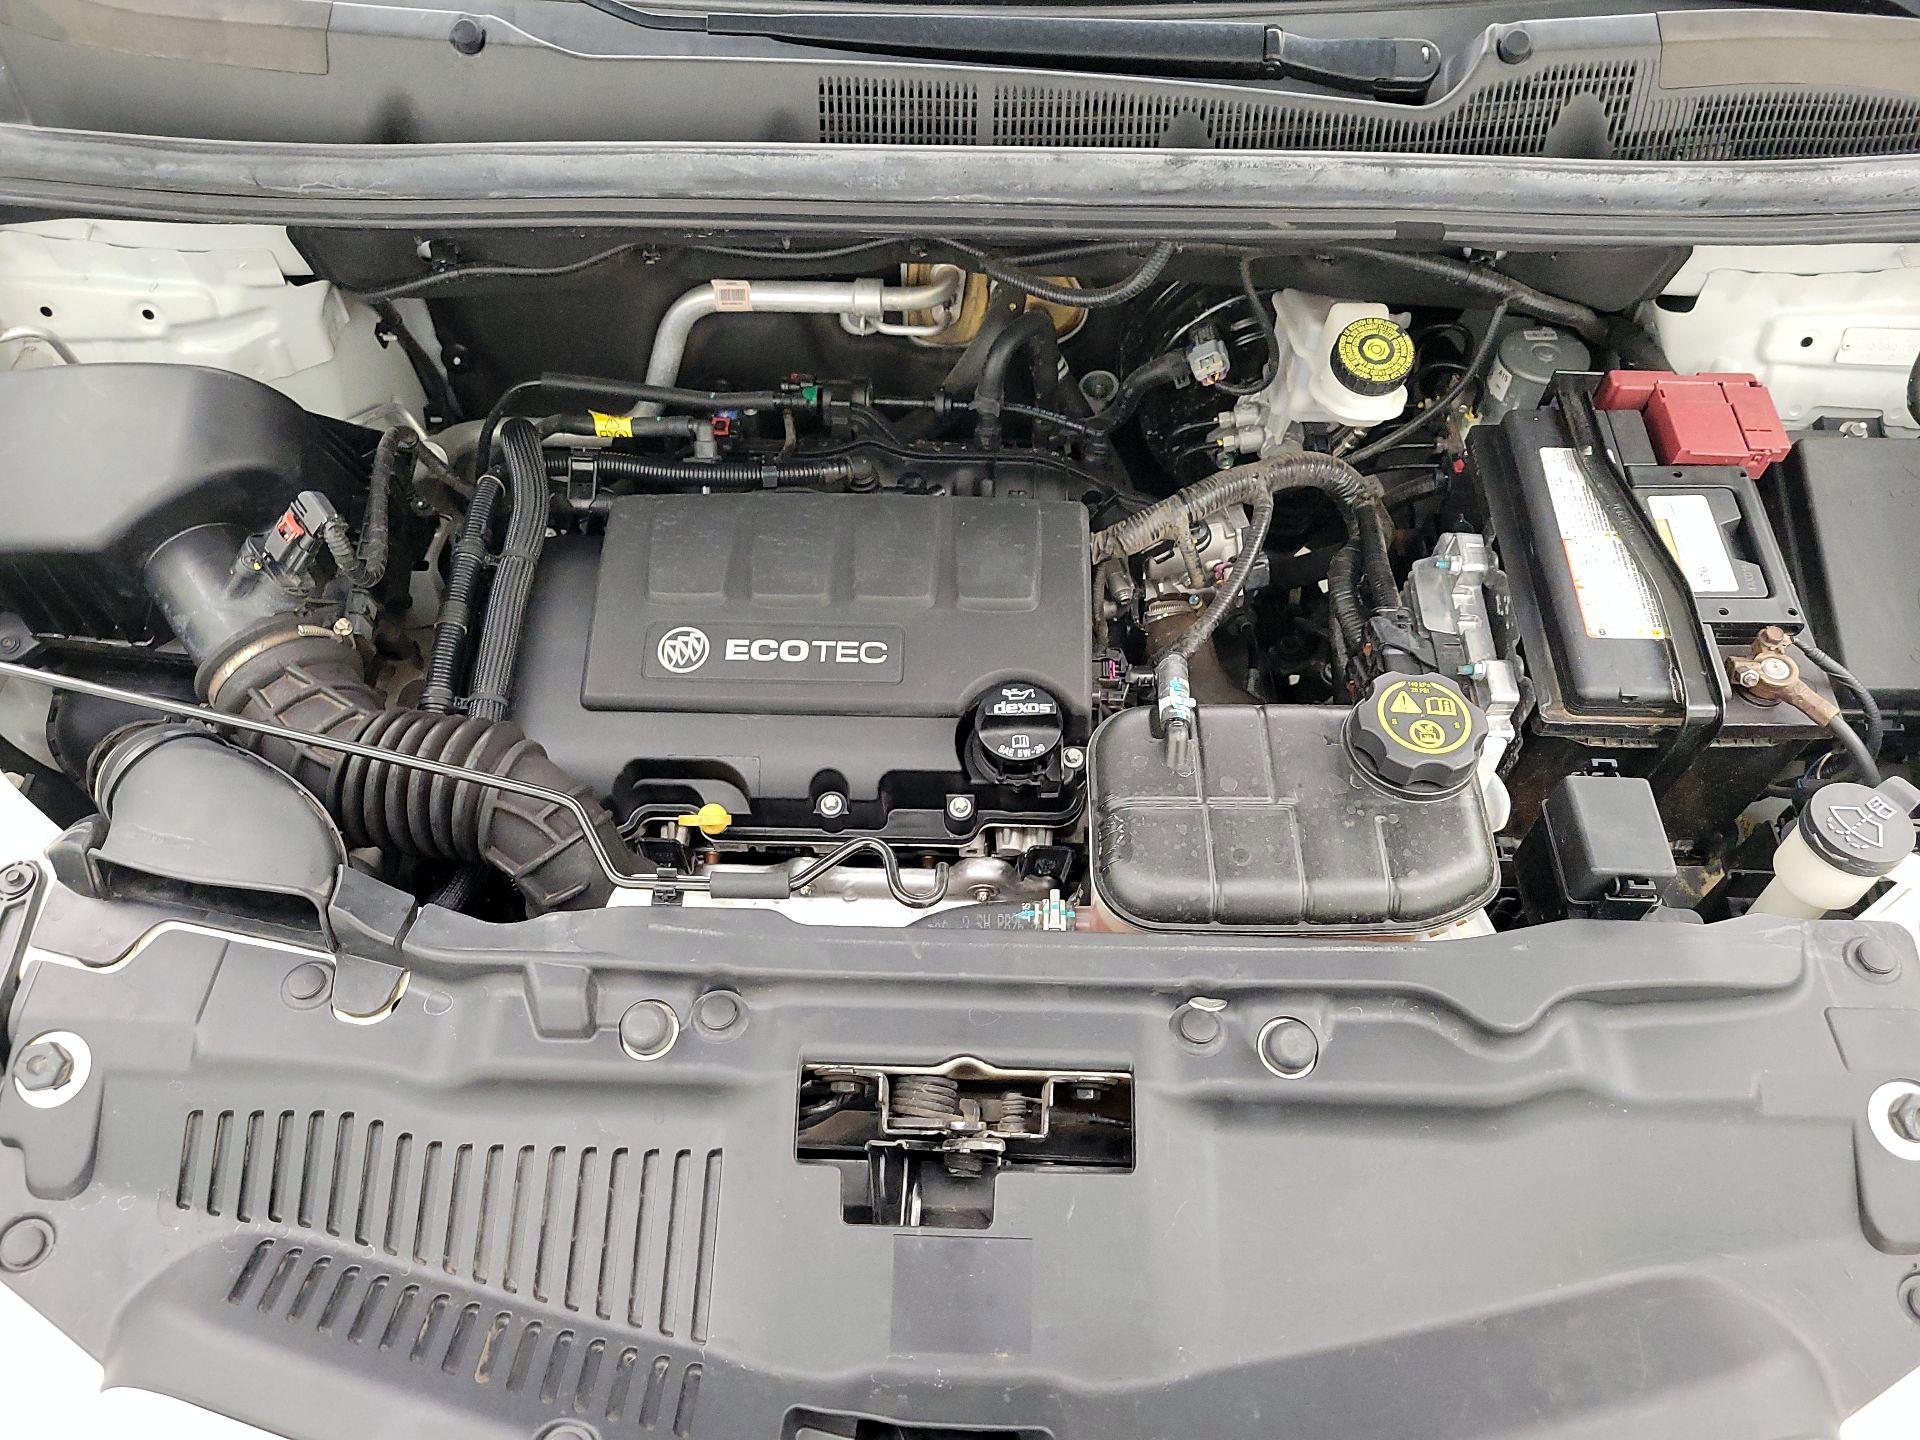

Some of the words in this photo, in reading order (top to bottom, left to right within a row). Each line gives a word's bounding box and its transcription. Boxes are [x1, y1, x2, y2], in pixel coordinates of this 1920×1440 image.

[725, 639, 888, 664] ECOTEC
[993, 701, 1053, 714] dexos
[997, 744, 1015, 757] SAE
